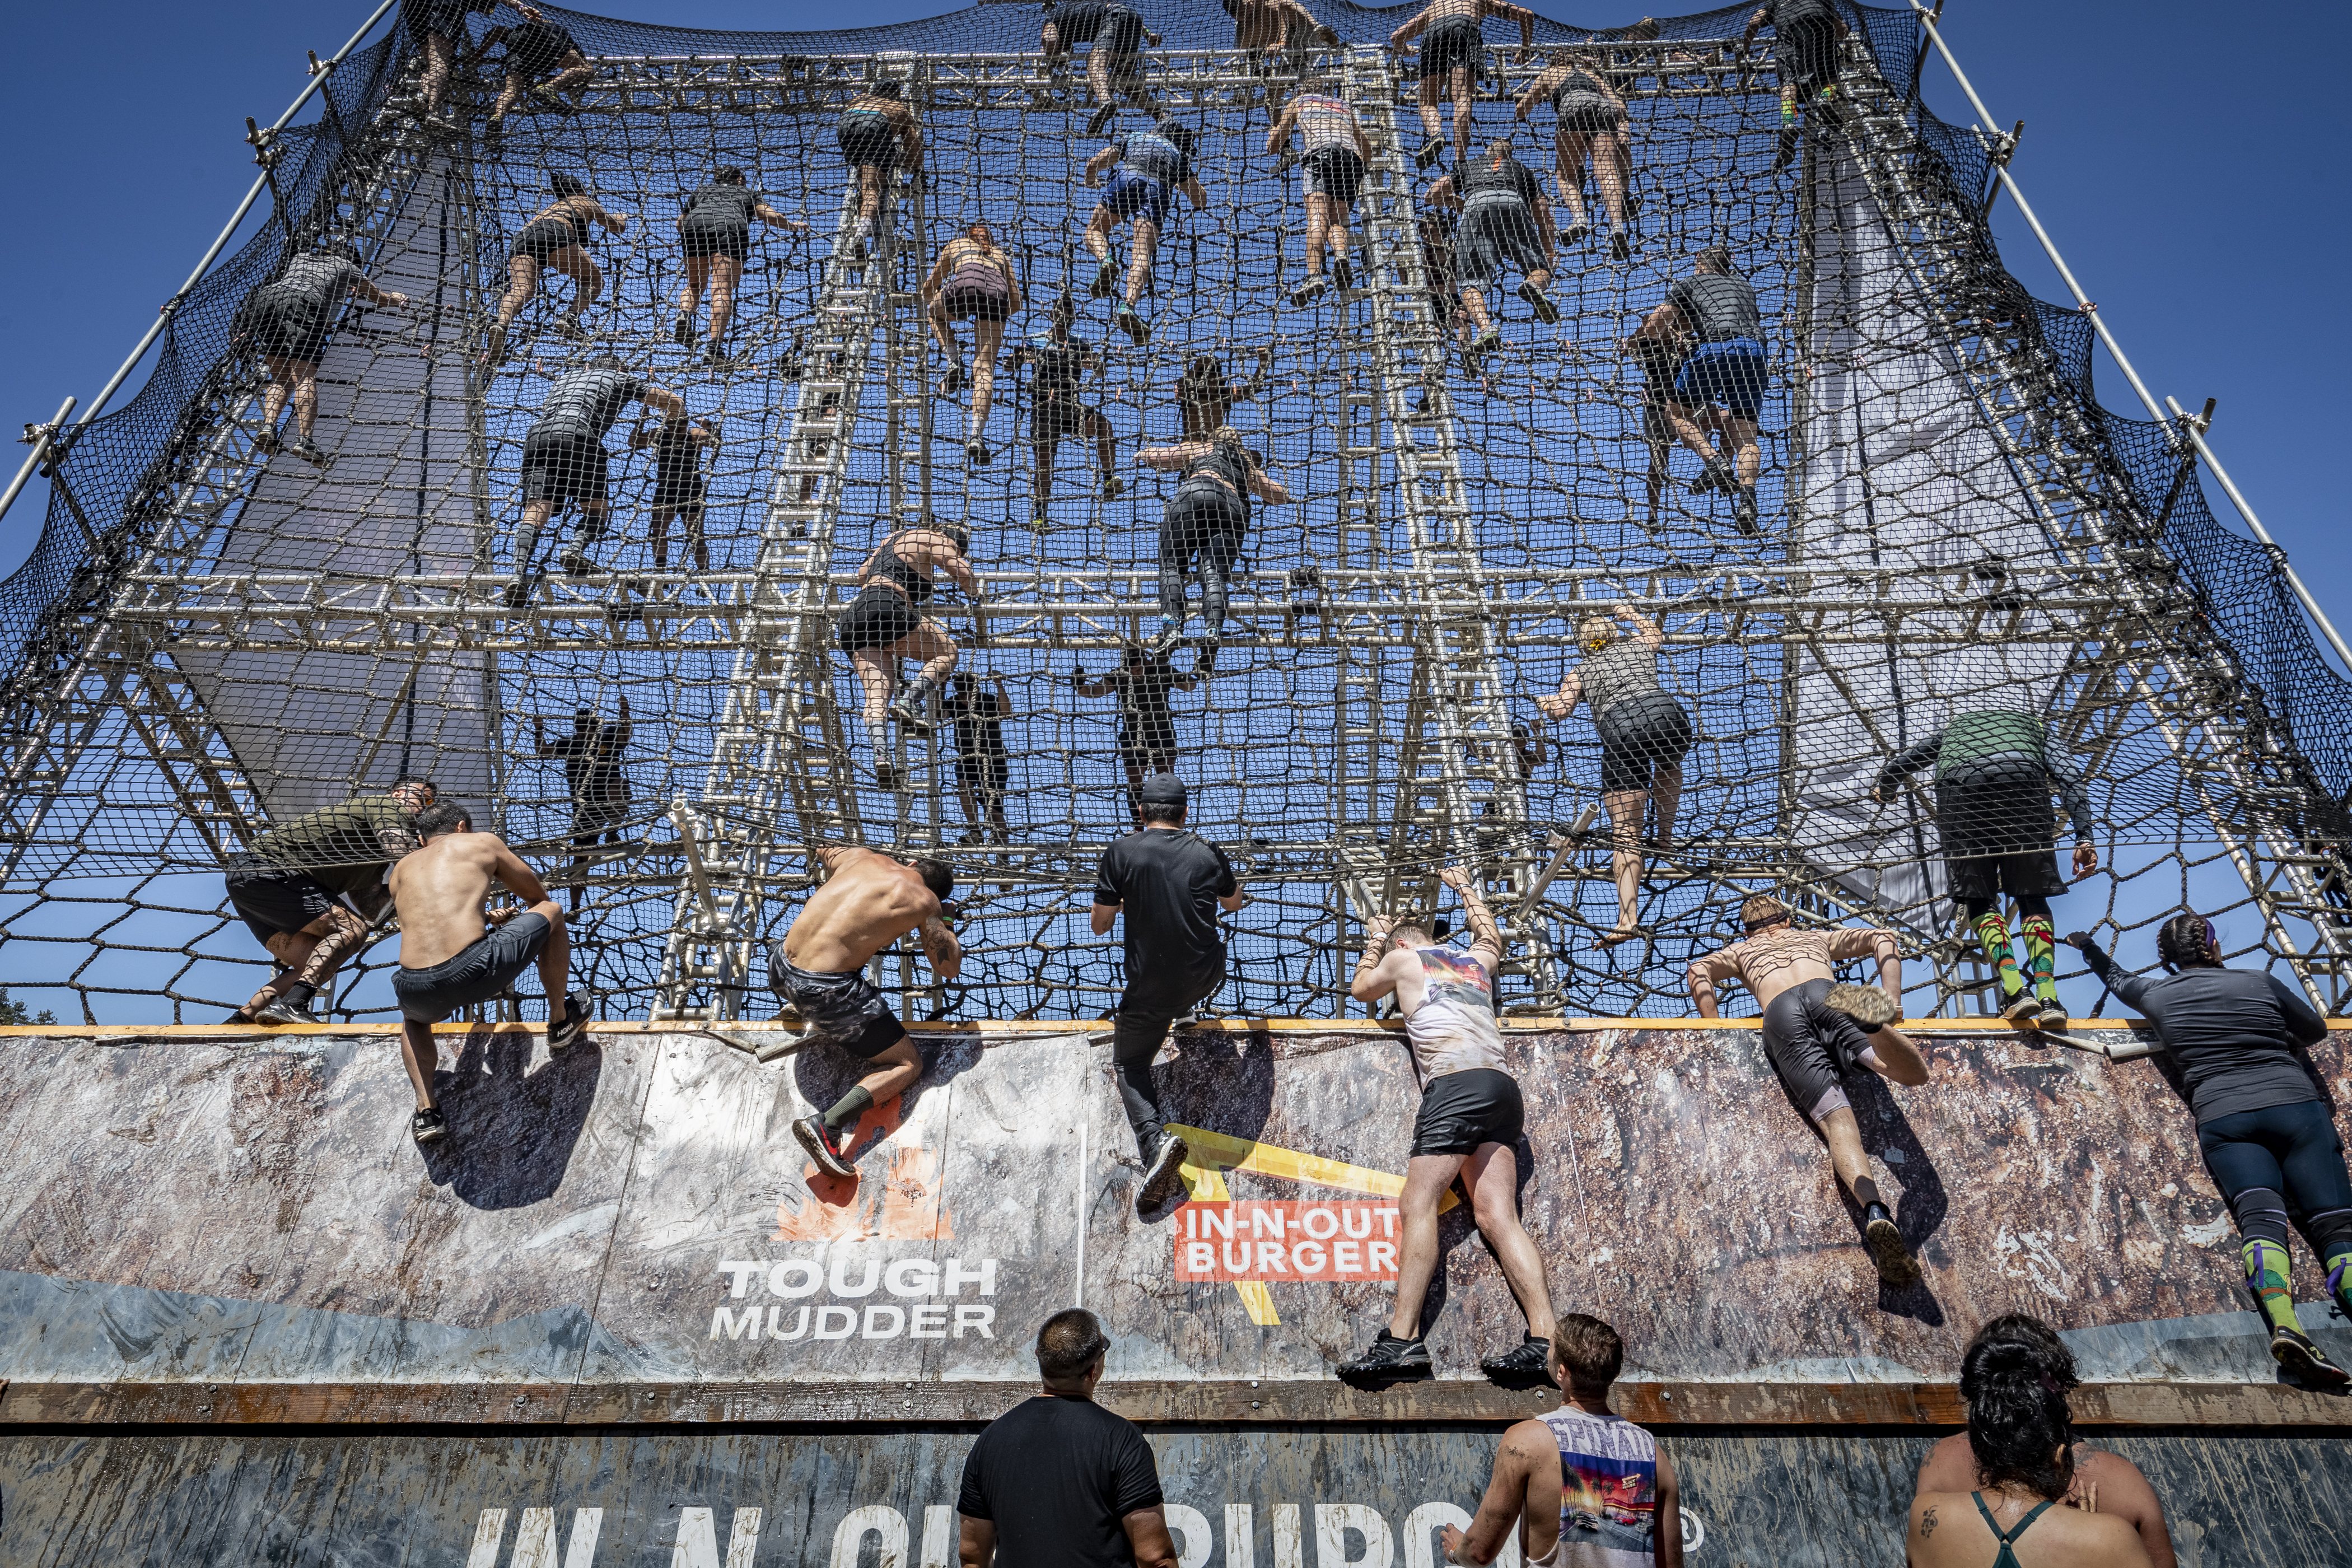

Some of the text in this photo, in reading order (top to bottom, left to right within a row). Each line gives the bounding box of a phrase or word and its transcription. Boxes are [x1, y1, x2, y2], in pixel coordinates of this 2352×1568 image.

[557, 1023, 573, 1037] HOKA
[1186, 1207, 1399, 1239] IN-N-OUT
[1187, 1240, 1399, 1273] BURGER
[717, 1258, 997, 1298] TOUGH
[709, 1304, 996, 1341] MUDDER
